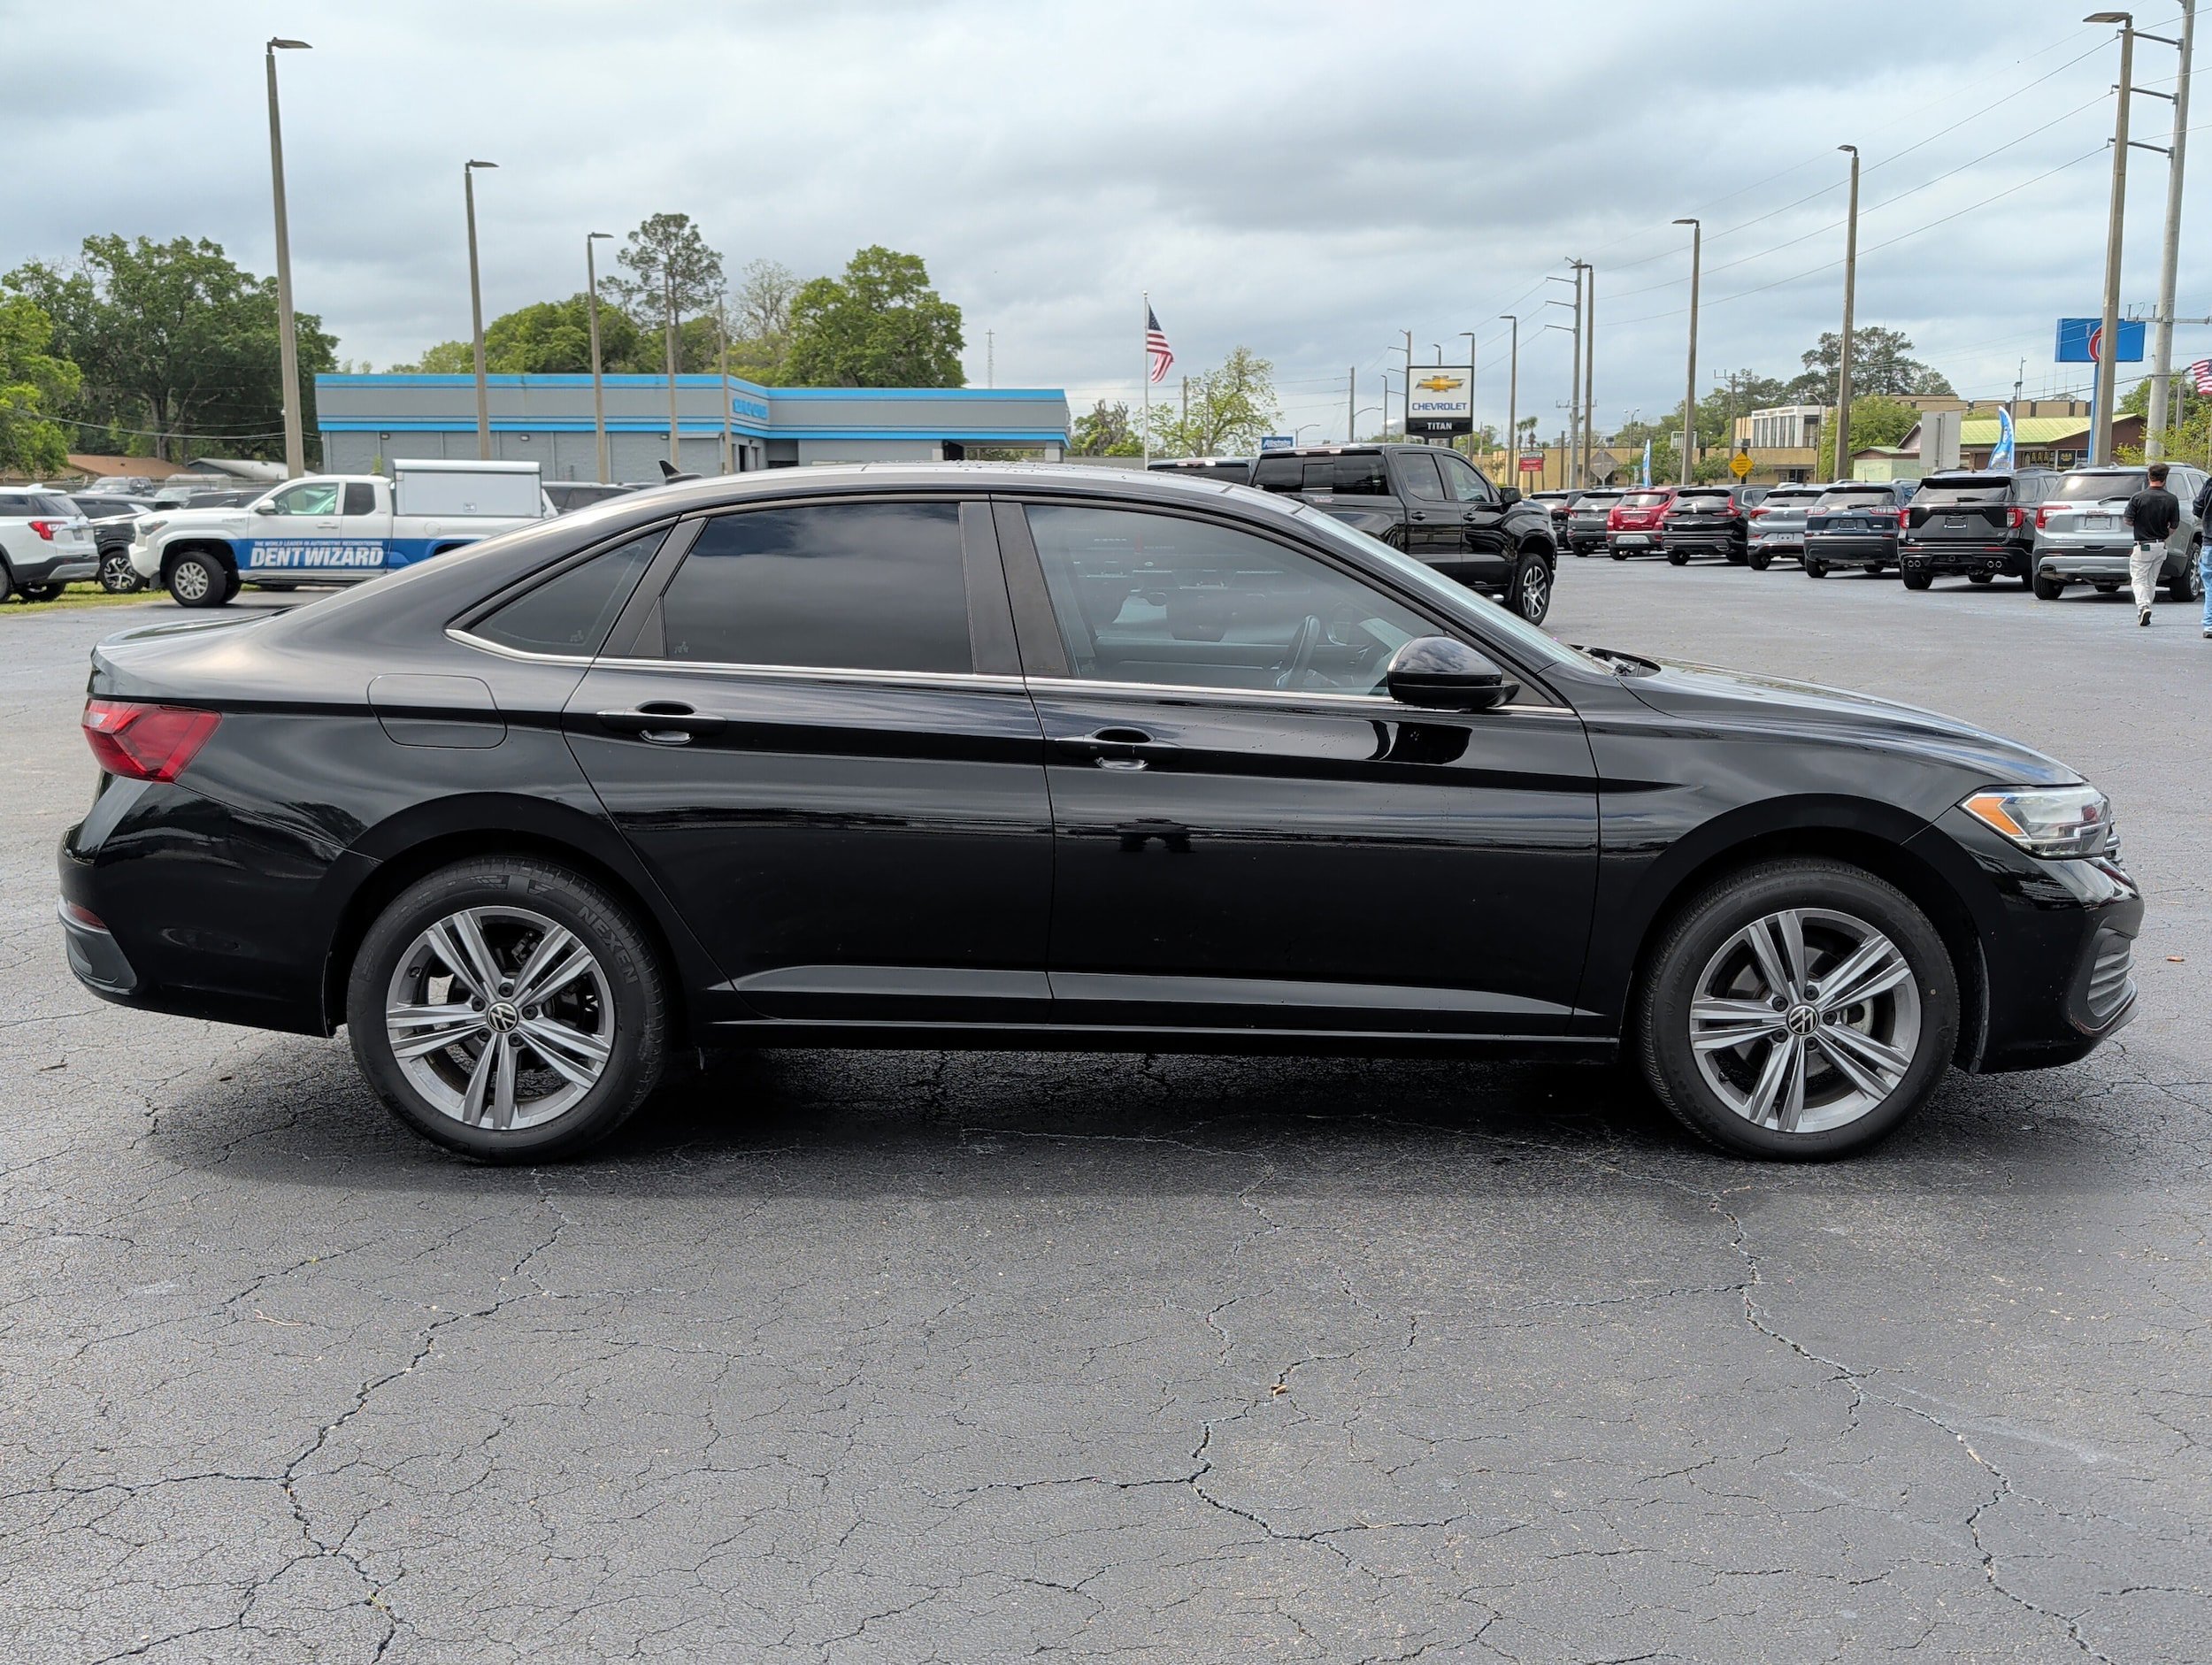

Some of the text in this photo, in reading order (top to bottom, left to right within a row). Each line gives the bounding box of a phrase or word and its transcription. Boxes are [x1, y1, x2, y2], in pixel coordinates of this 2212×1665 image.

[250, 547, 384, 567] DENT WIZARD
[577, 905, 638, 984] NEXEN
